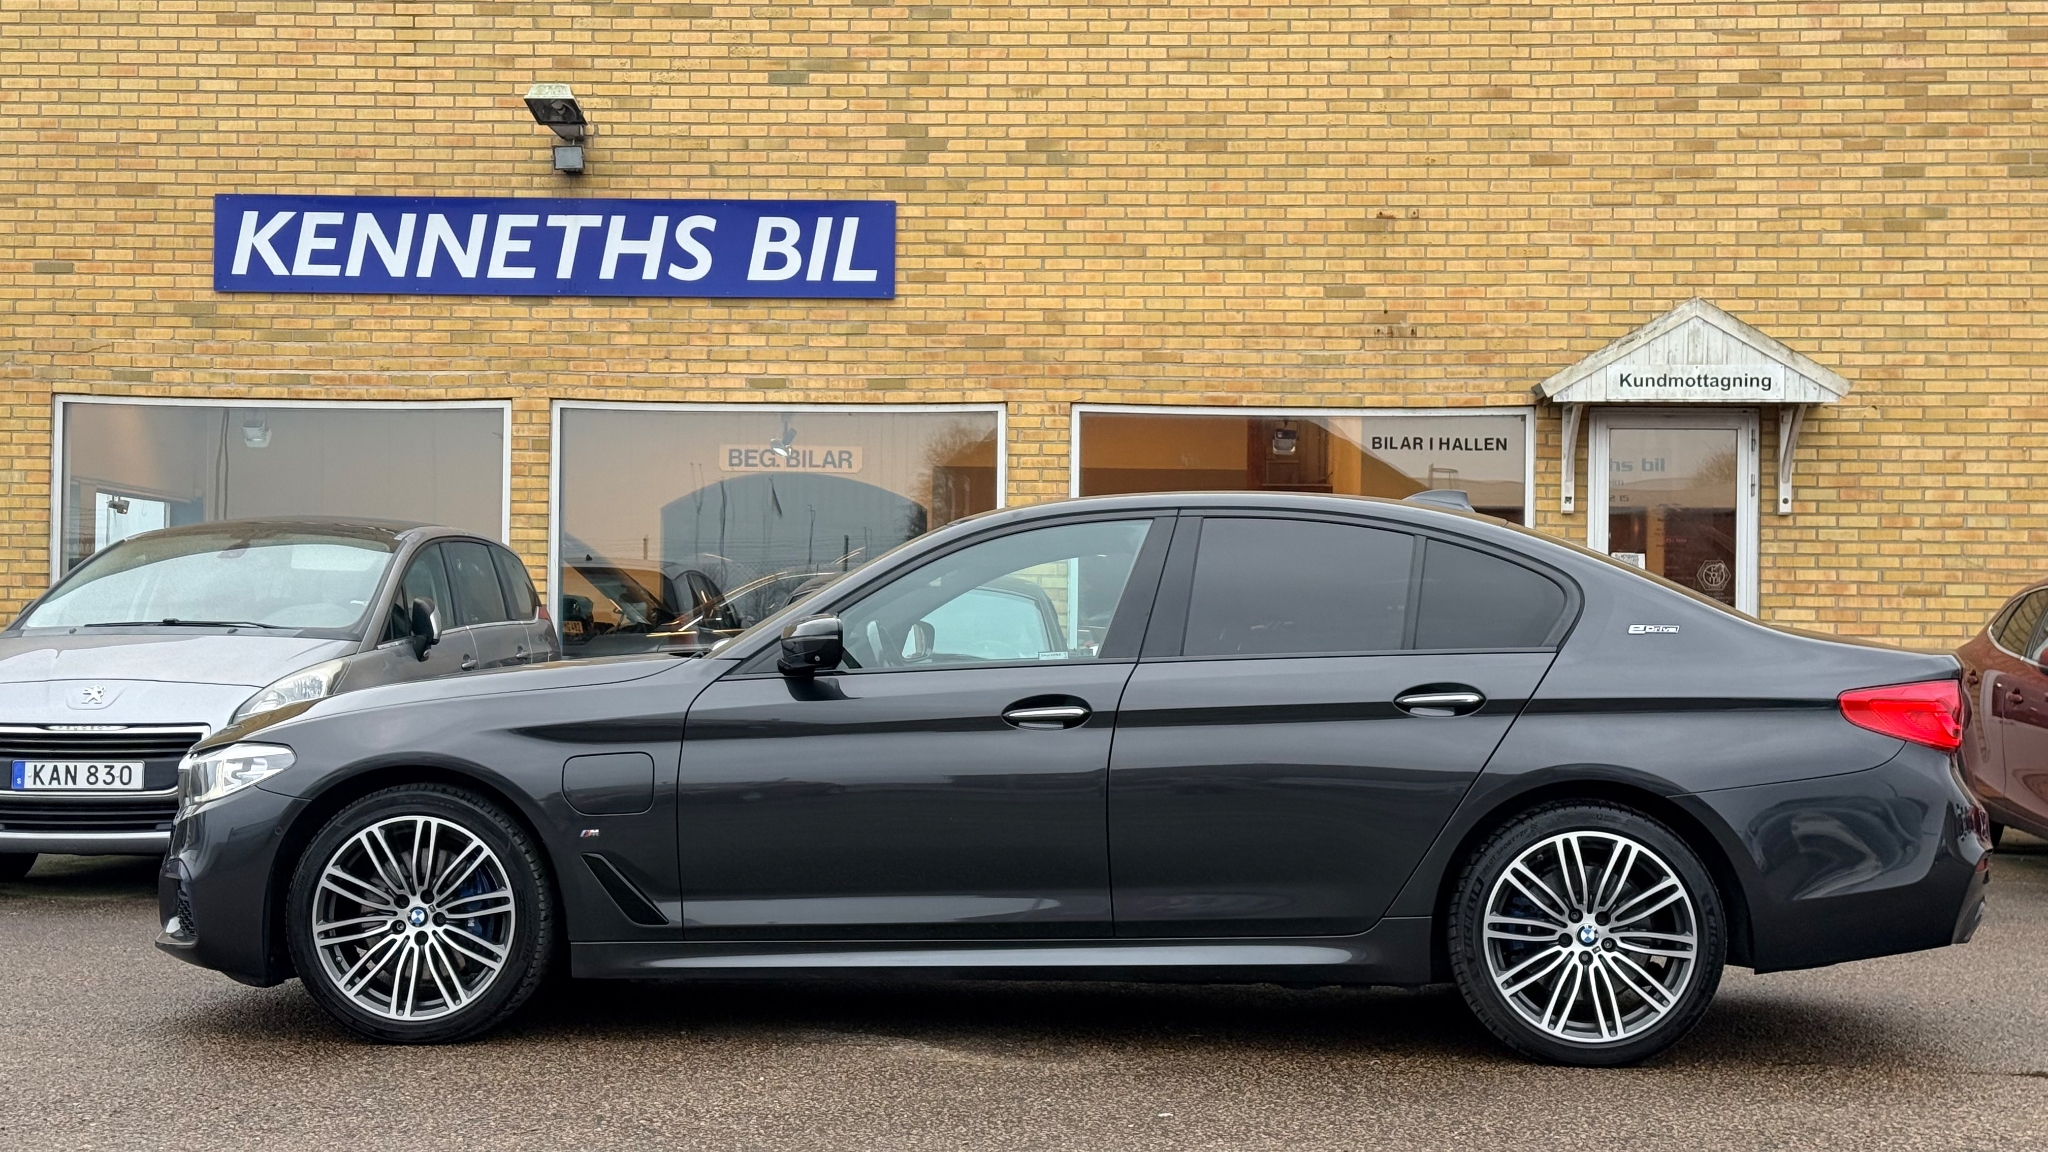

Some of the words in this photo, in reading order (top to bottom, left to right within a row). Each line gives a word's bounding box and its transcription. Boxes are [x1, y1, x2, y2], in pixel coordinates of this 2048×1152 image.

[230, 210, 717, 283] KENNETHS
[746, 216, 879, 283] BIL
[1619, 373, 1773, 391] Kundmottagning
[1371, 436, 1424, 450] BILAR
[1429, 437, 1434, 450] I
[1438, 437, 1508, 451] HALLEN
[728, 448, 780, 468] BEG.
[785, 450, 853, 469] BILAR
[1641, 457, 1665, 472] bil
[33, 764, 78, 787] KAN
[86, 764, 132, 787] 830
